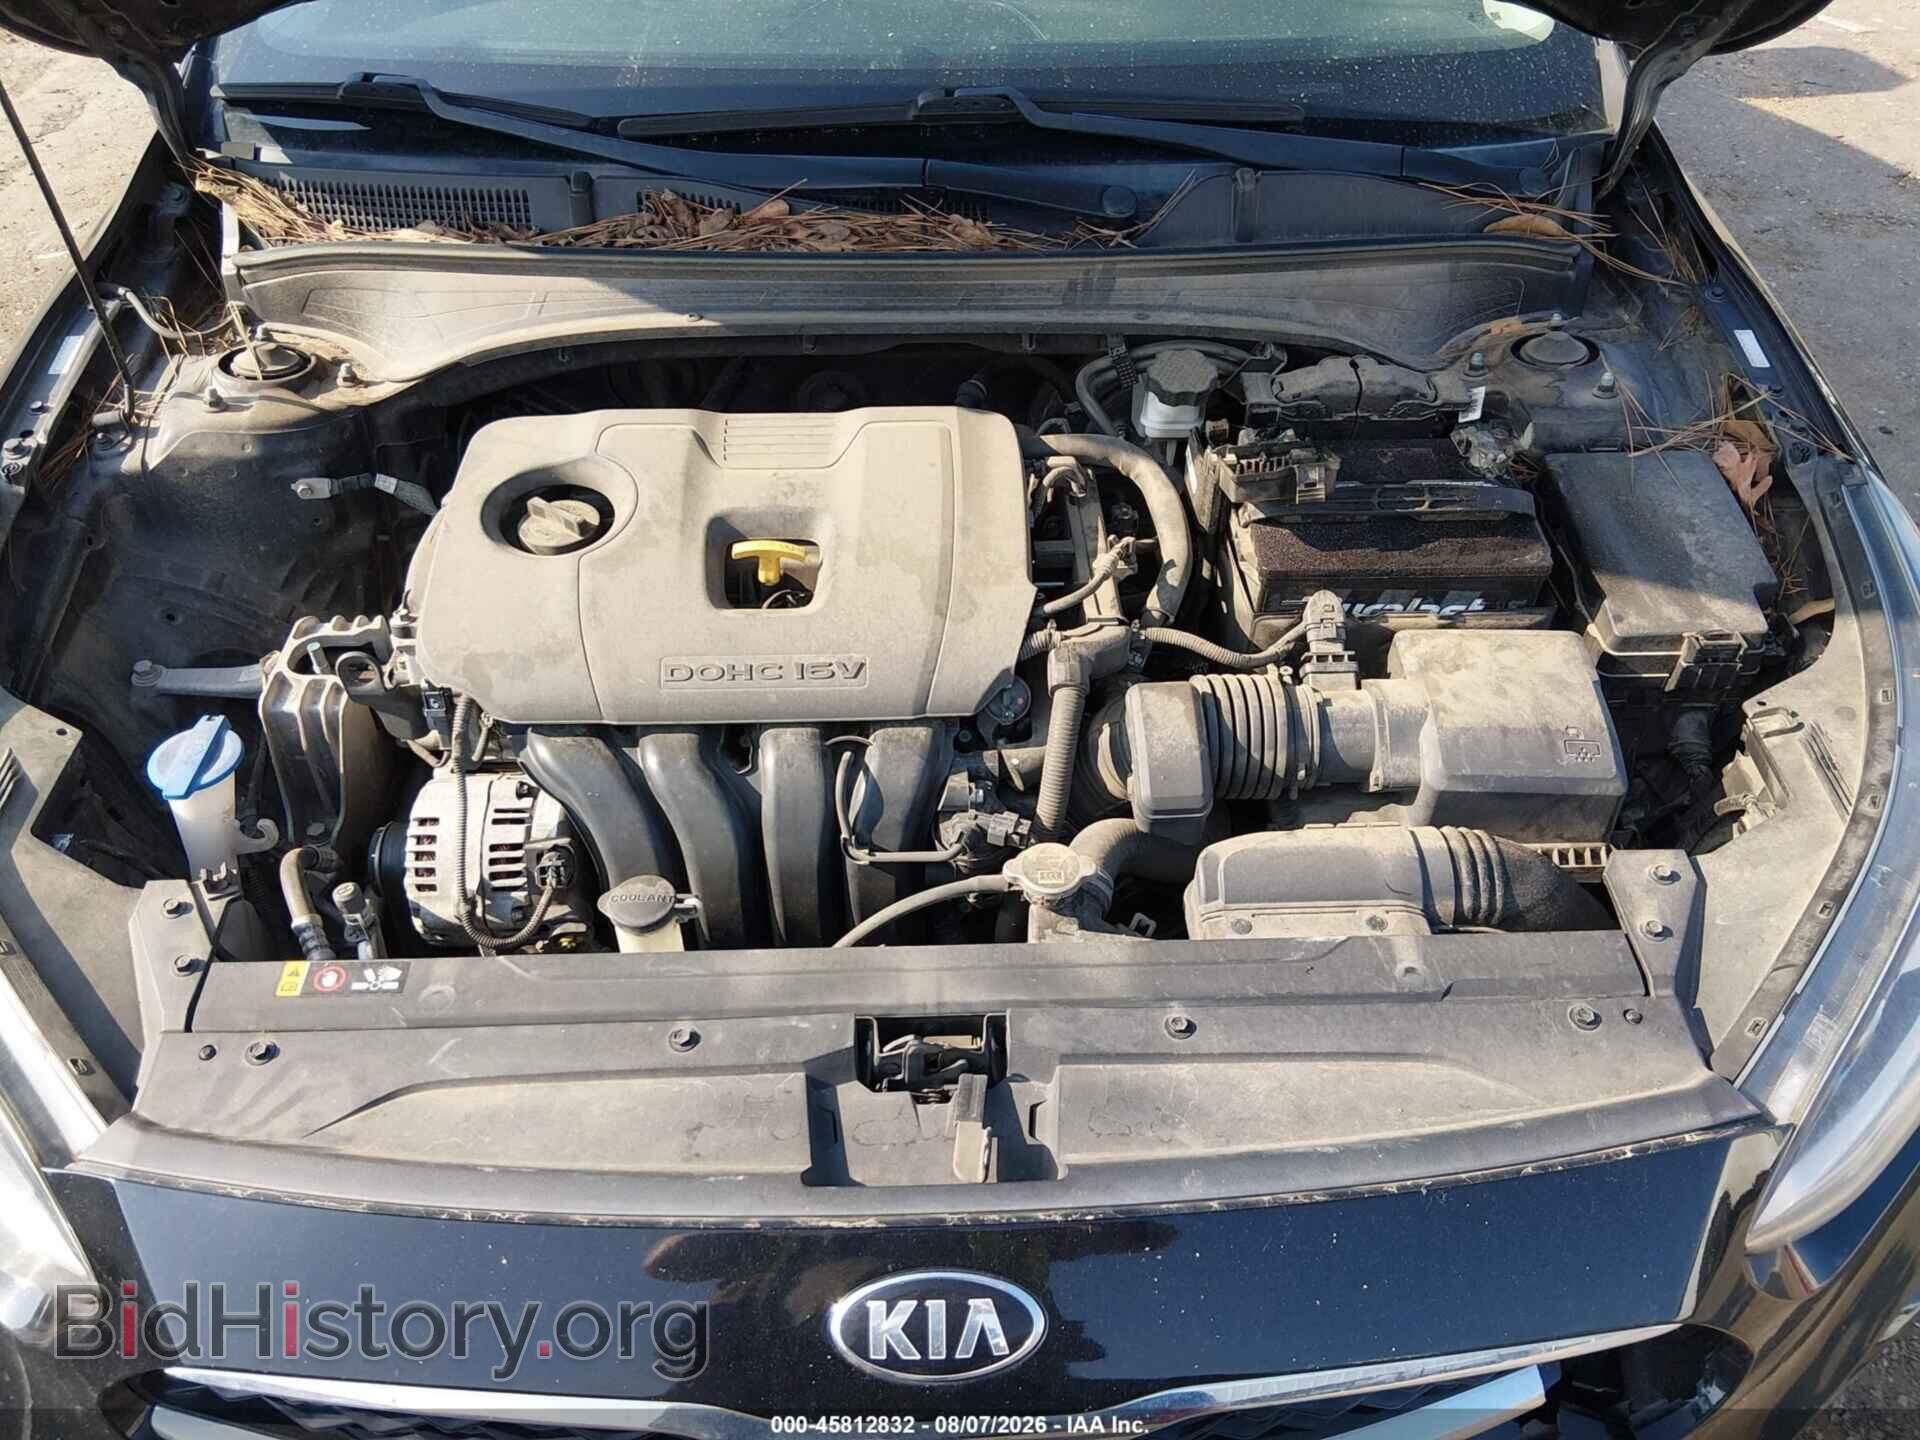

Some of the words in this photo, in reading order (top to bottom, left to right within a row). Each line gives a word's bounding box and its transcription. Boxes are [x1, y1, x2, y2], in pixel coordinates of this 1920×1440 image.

[664, 662, 784, 683] DOHC
[794, 660, 867, 682] 16V
[610, 893, 674, 904] COOLANT
[865, 1297, 1011, 1360] KIA
